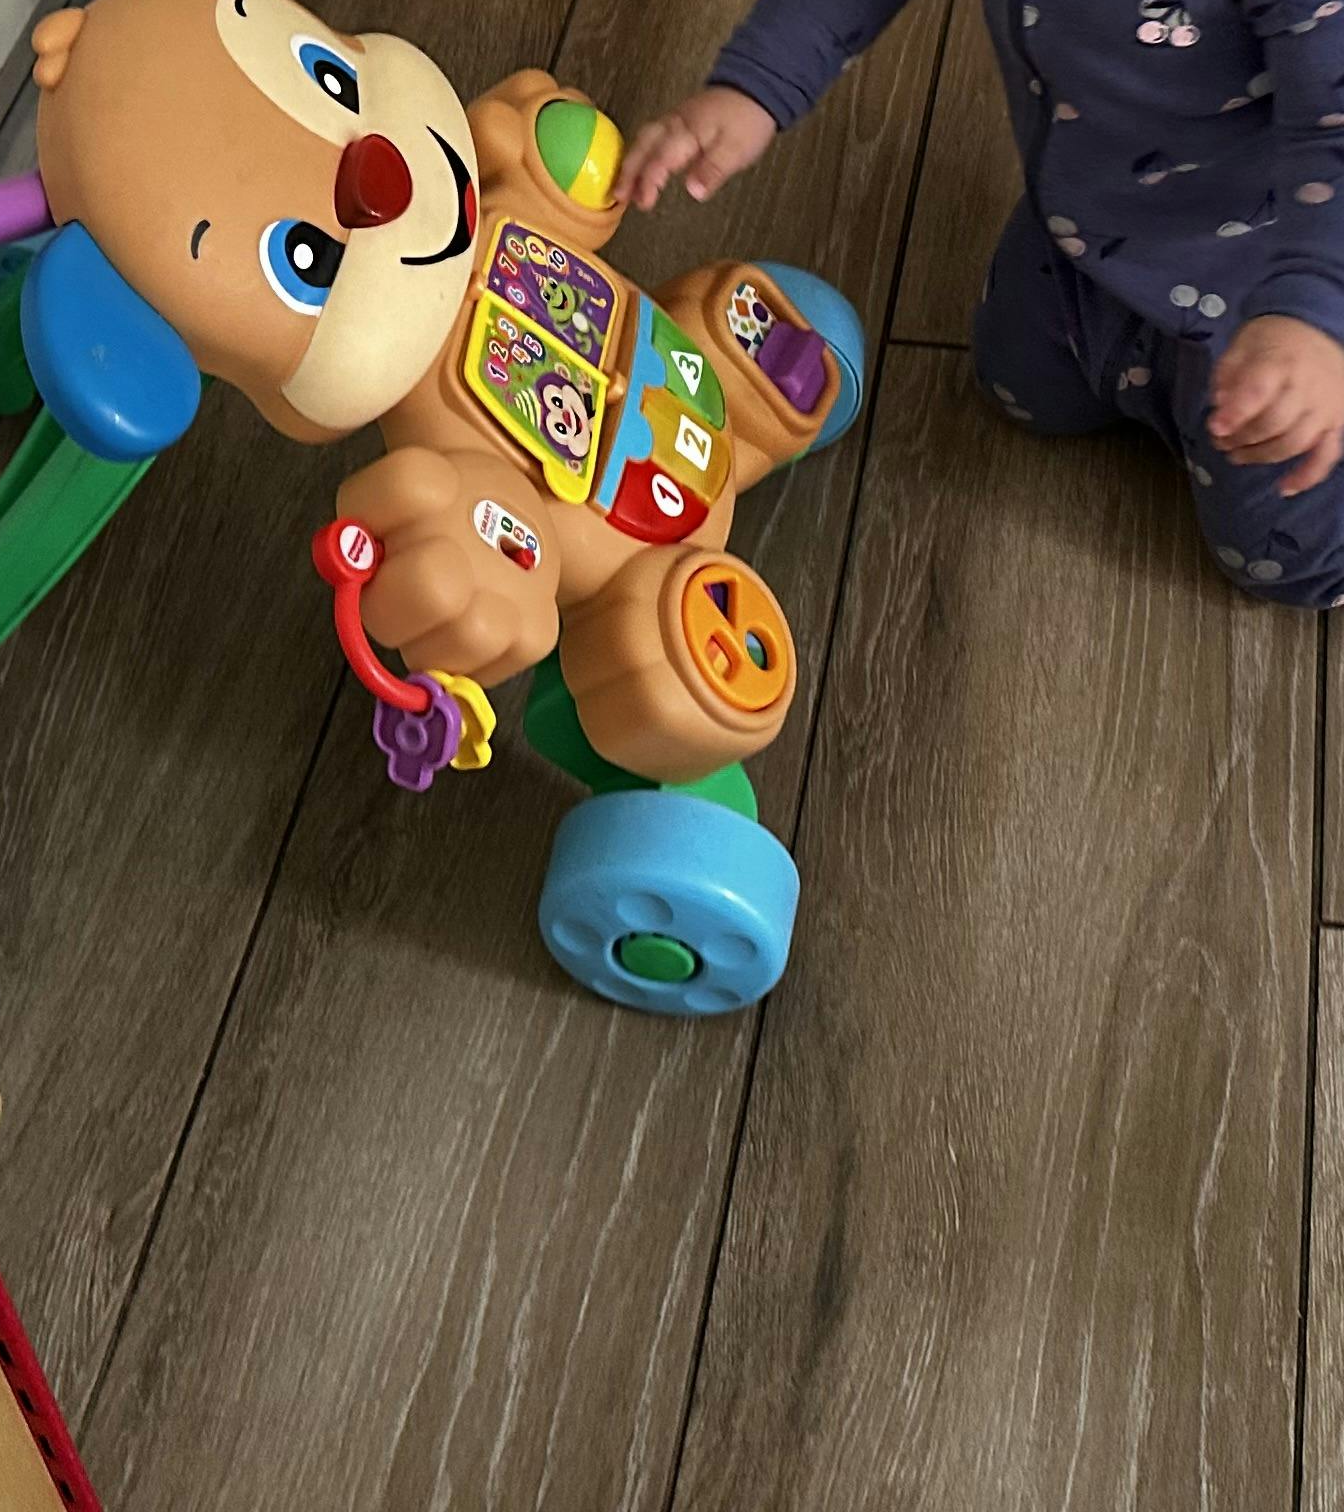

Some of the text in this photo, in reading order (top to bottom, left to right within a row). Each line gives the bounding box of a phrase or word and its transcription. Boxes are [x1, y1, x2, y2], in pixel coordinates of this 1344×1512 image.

[500, 254, 517, 275] 7
[510, 238, 525, 257] 8
[548, 248, 567, 270] 10
[490, 341, 508, 361] 2
[678, 354, 700, 381] 3
[683, 427, 707, 459] 2
[656, 481, 680, 505] 1
[480, 501, 492, 535] SMART
